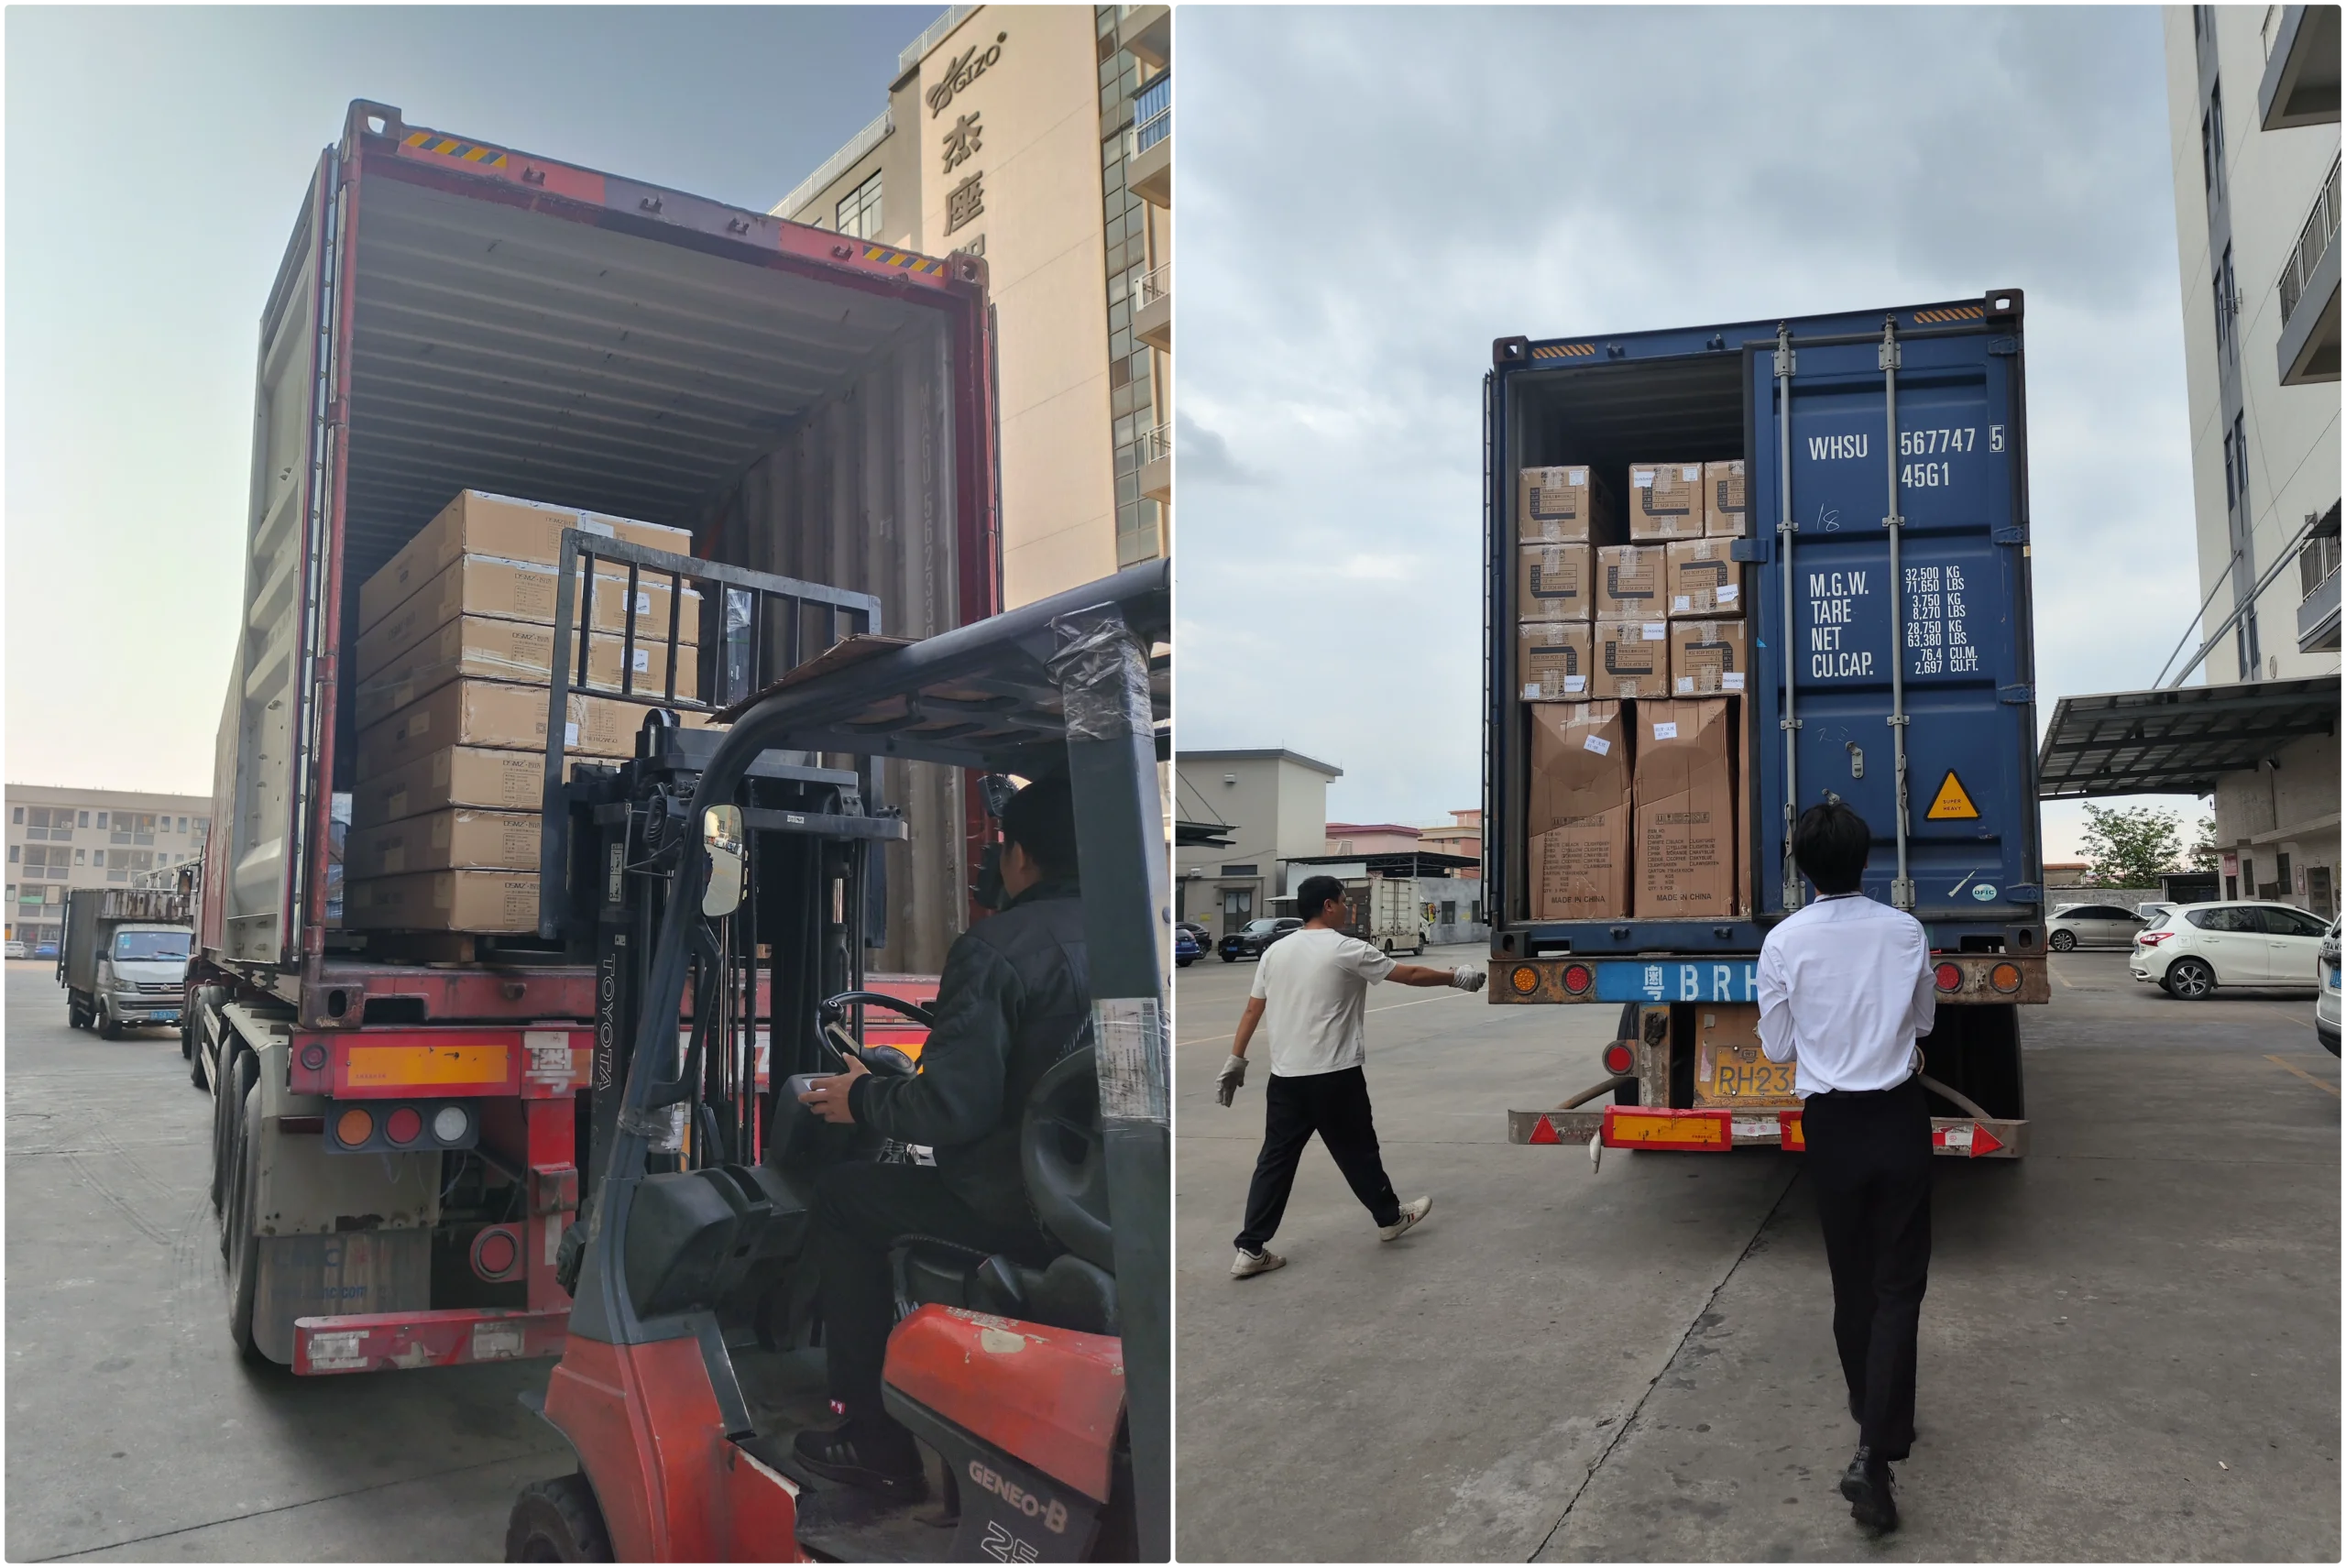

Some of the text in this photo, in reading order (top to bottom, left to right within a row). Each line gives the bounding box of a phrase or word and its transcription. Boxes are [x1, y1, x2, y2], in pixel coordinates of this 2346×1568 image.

[1809, 426, 2003, 461] WHSU 567747 5
[1901, 462, 1949, 488] 45G1
[1815, 503, 1841, 532] 18
[1810, 565, 1960, 598] M.G.W. 32,500 KG
[1905, 577, 1965, 594] 71,650 LBS
[1811, 593, 1961, 624] TARE 3,750 KG
[1913, 605, 1966, 620] 8,270 LBS
[1811, 620, 1963, 652] NET 28,750 KG
[1907, 632, 1967, 648] 63,380 LBS
[1812, 646, 1978, 678] CU.CAP. 76.4 CU.M.
[1914, 658, 1979, 675] 2,697 CU.FT.
[598, 954, 616, 1091] TOYOTA
[1718, 1066, 1792, 1092] RH23
[969, 1459, 1068, 1534] GENEO-B
